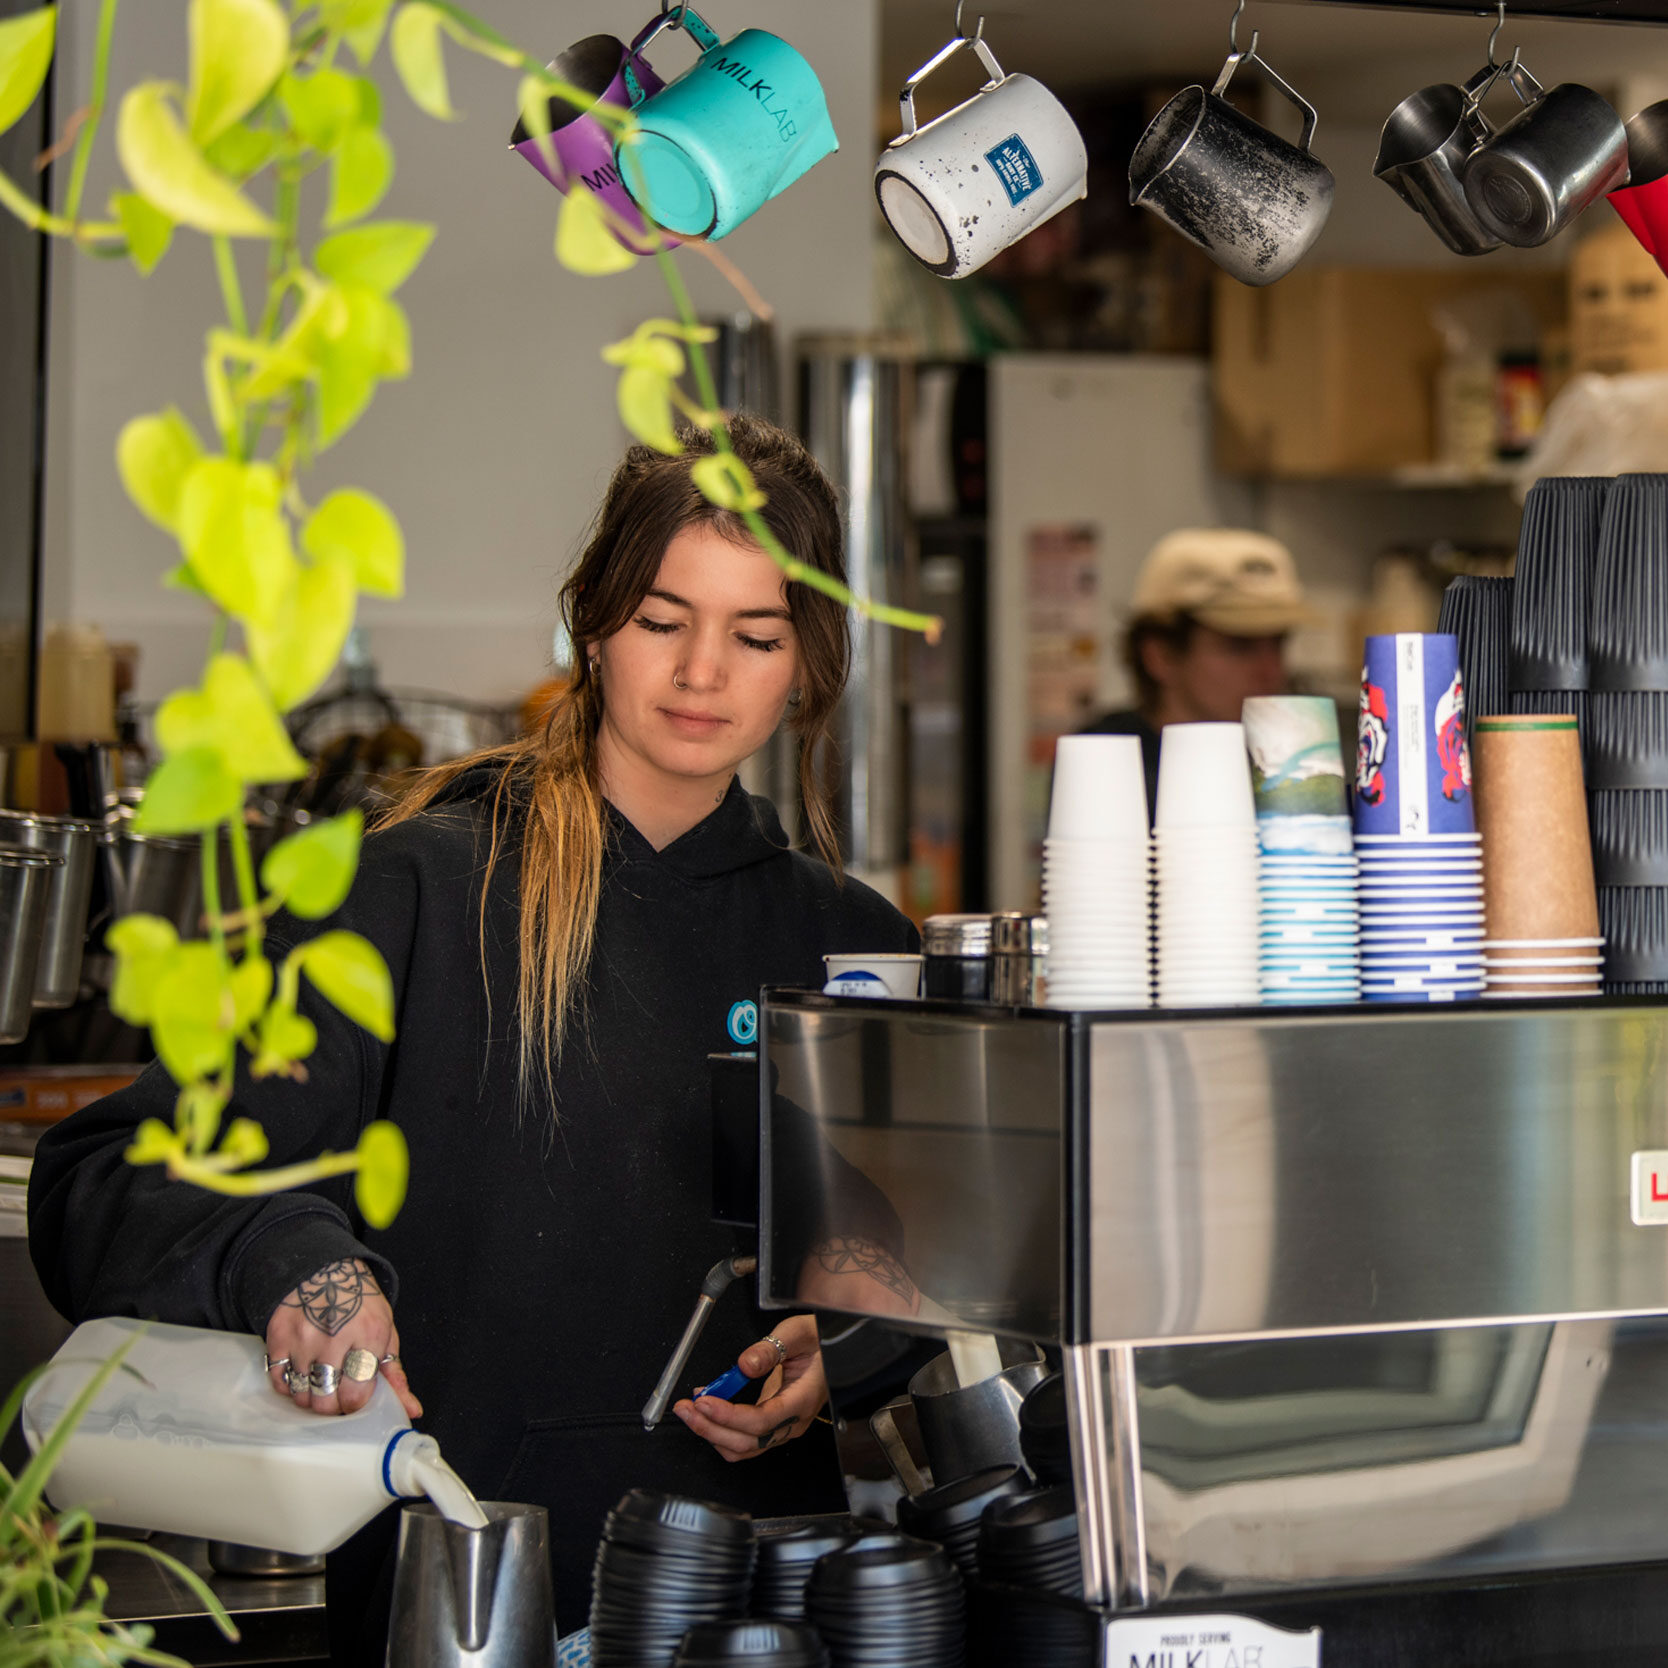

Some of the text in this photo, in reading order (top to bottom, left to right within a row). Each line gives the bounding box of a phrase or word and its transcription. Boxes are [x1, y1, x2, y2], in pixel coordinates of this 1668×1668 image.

[709, 57, 797, 142] MILKLAB
[1002, 147, 1032, 191] ALTERNATIVE
[1160, 1631, 1230, 1646] PROUDLY SERVING
